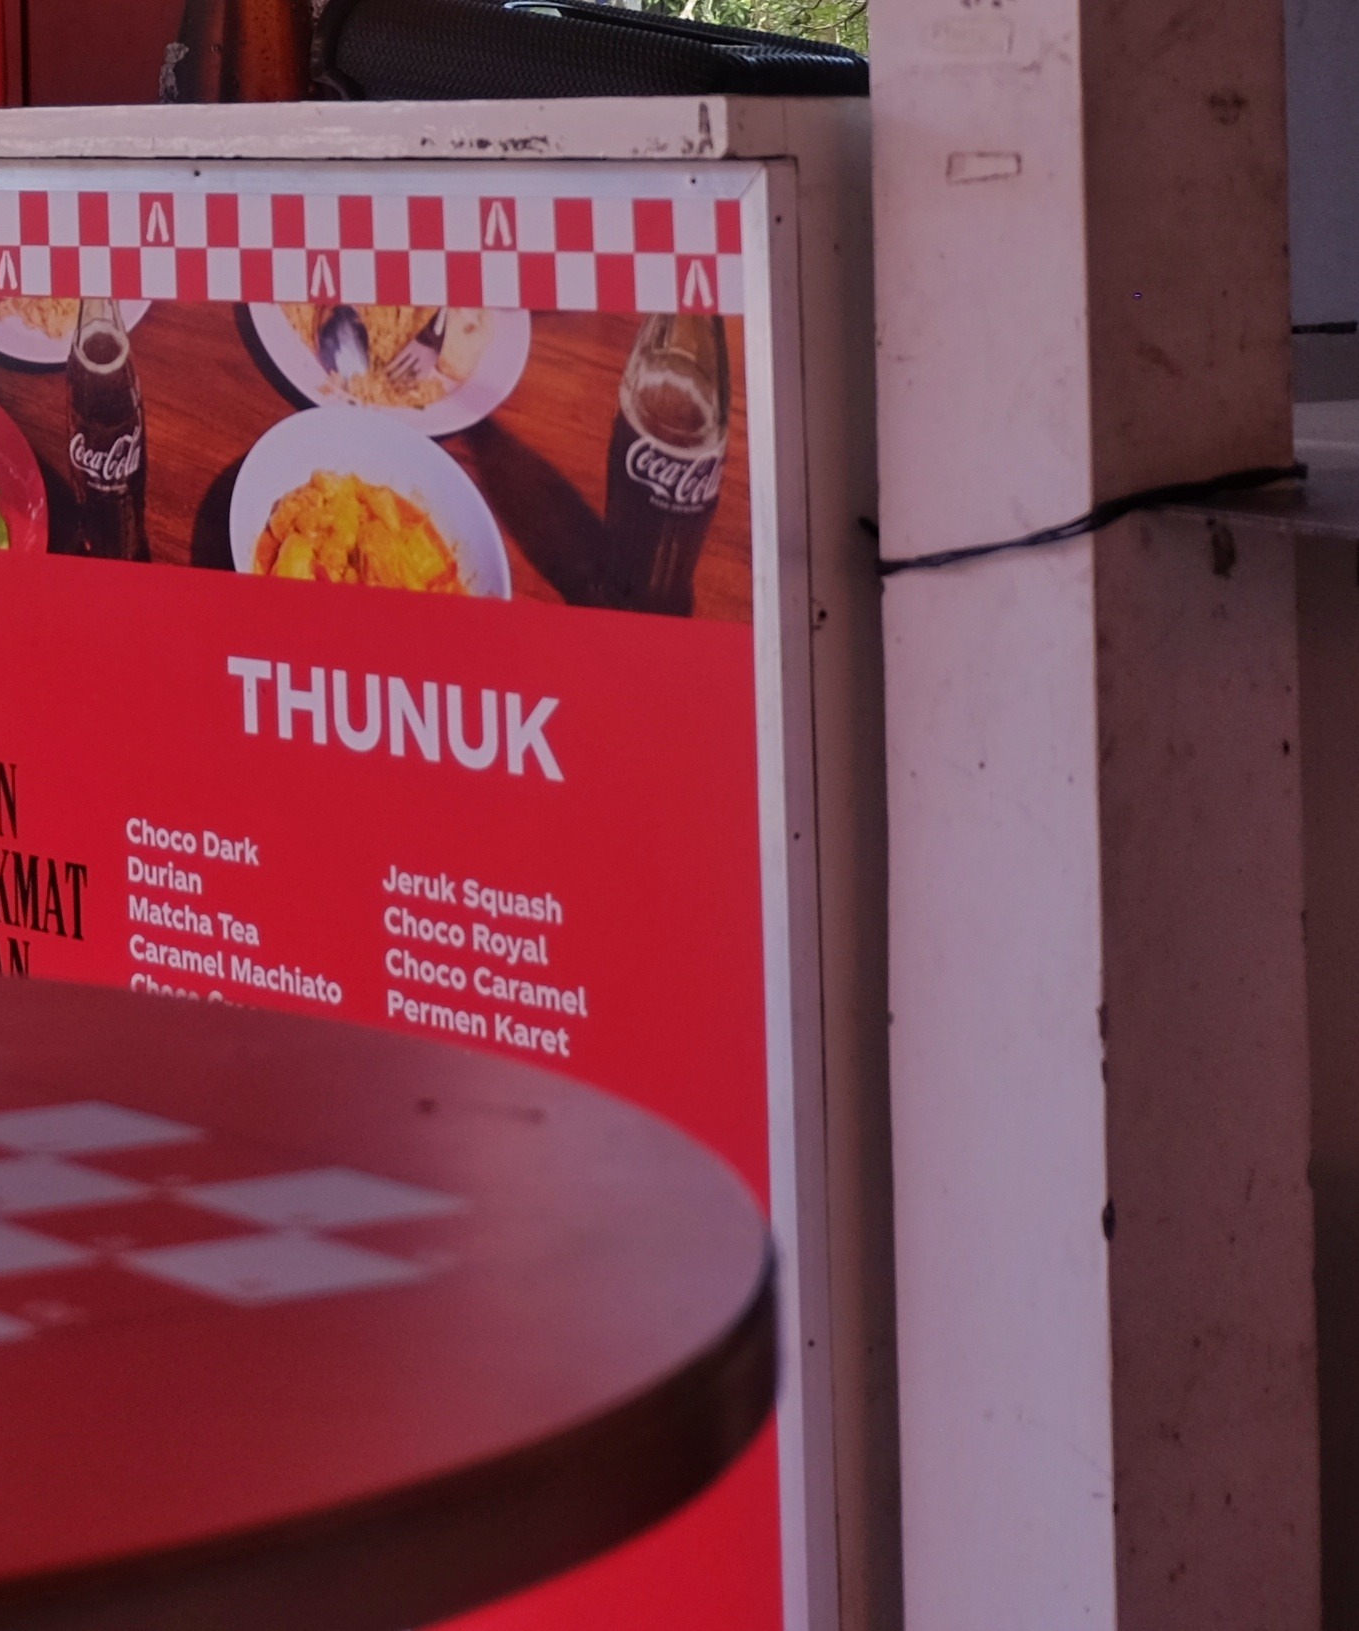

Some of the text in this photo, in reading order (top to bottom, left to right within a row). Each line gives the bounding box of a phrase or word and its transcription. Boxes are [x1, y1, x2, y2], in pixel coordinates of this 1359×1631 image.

[226, 653, 565, 781] THUNUK
[126, 817, 259, 866] Choco Dark
[127, 856, 202, 895] Durian
[382, 865, 563, 925] Jeruk Squash
[129, 894, 260, 947] Matcha Tea
[384, 906, 549, 966] Choco Royal
[129, 934, 225, 979] Caramel
[231, 955, 343, 1005] Machiato
[385, 948, 588, 1017] Choco Caramel
[387, 989, 570, 1058] Permen Karet
